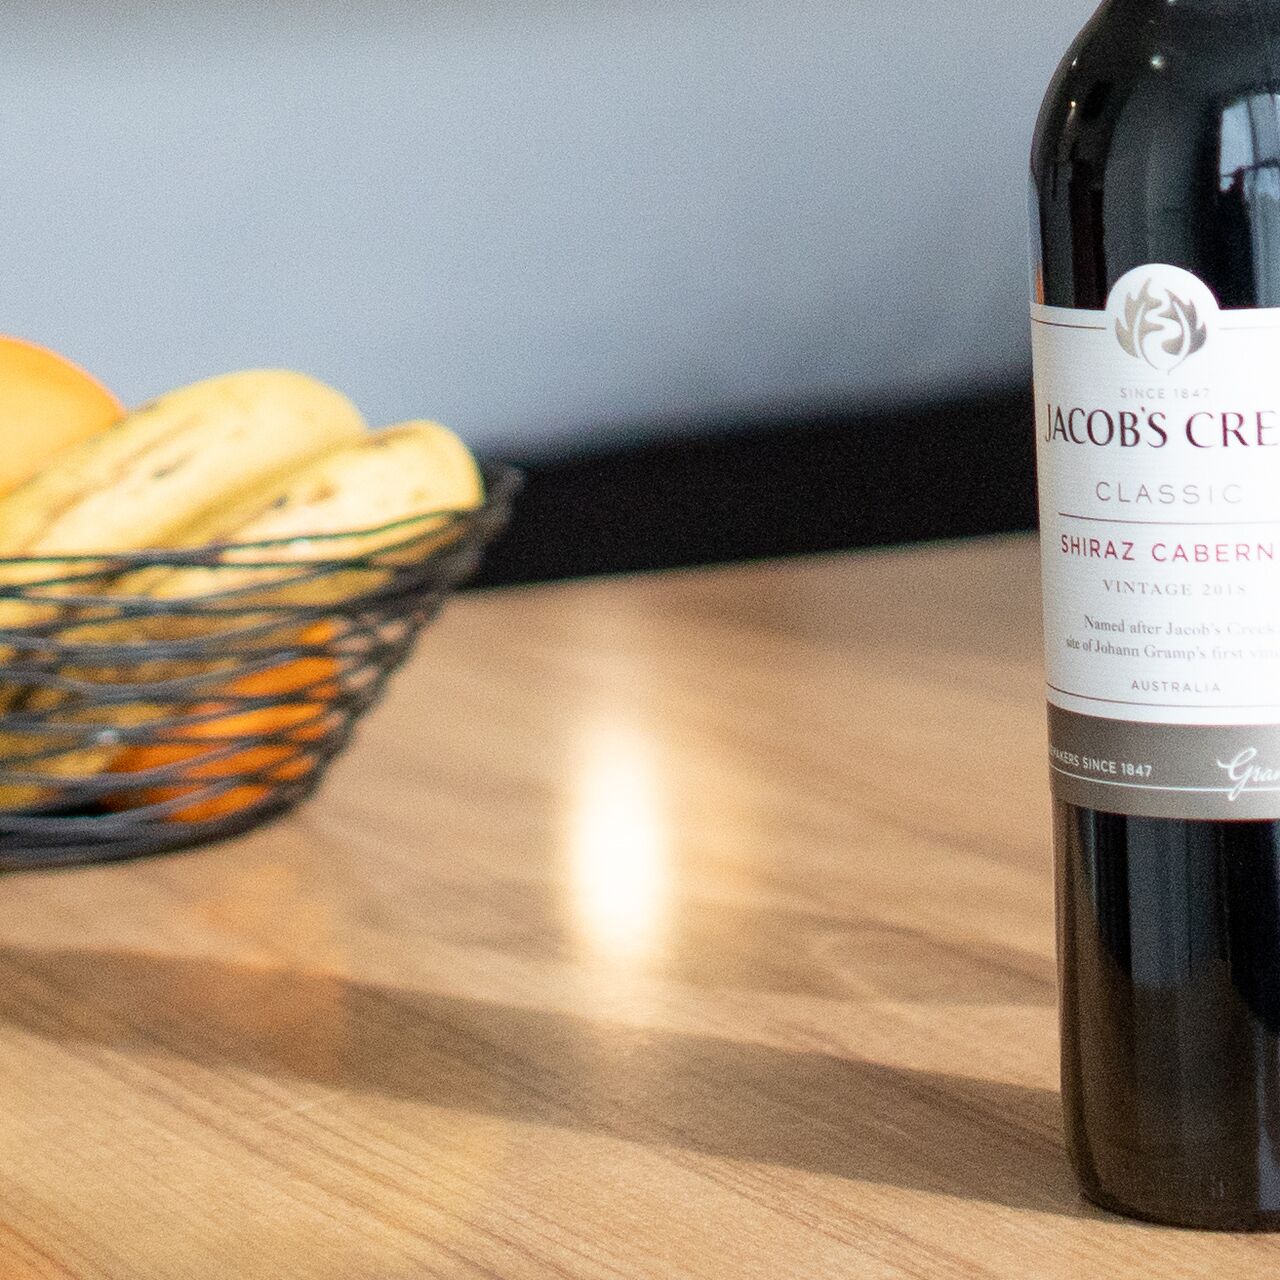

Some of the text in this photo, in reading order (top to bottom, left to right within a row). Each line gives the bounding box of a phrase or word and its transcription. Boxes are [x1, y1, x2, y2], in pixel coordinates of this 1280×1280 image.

[1119, 387, 1210, 400] SINCE 1847
[1044, 403, 1168, 448] JACOB'S
[1095, 481, 1244, 505] CLASSIC
[1061, 534, 1136, 561] SHIRAZ
[1102, 579, 1193, 597] VINTAGE
[1084, 614, 1126, 633] Named
[1130, 620, 1162, 635] after
[1165, 622, 1221, 637] Jacob's
[1082, 638, 1093, 652] of
[1094, 640, 1140, 658] Johann
[1144, 644, 1206, 662] Gramp's
[1212, 646, 1244, 660] first
[1131, 679, 1222, 694] AUSTRALIA
[1082, 756, 1117, 775] SINCE
[1121, 762, 1153, 778] 1847
